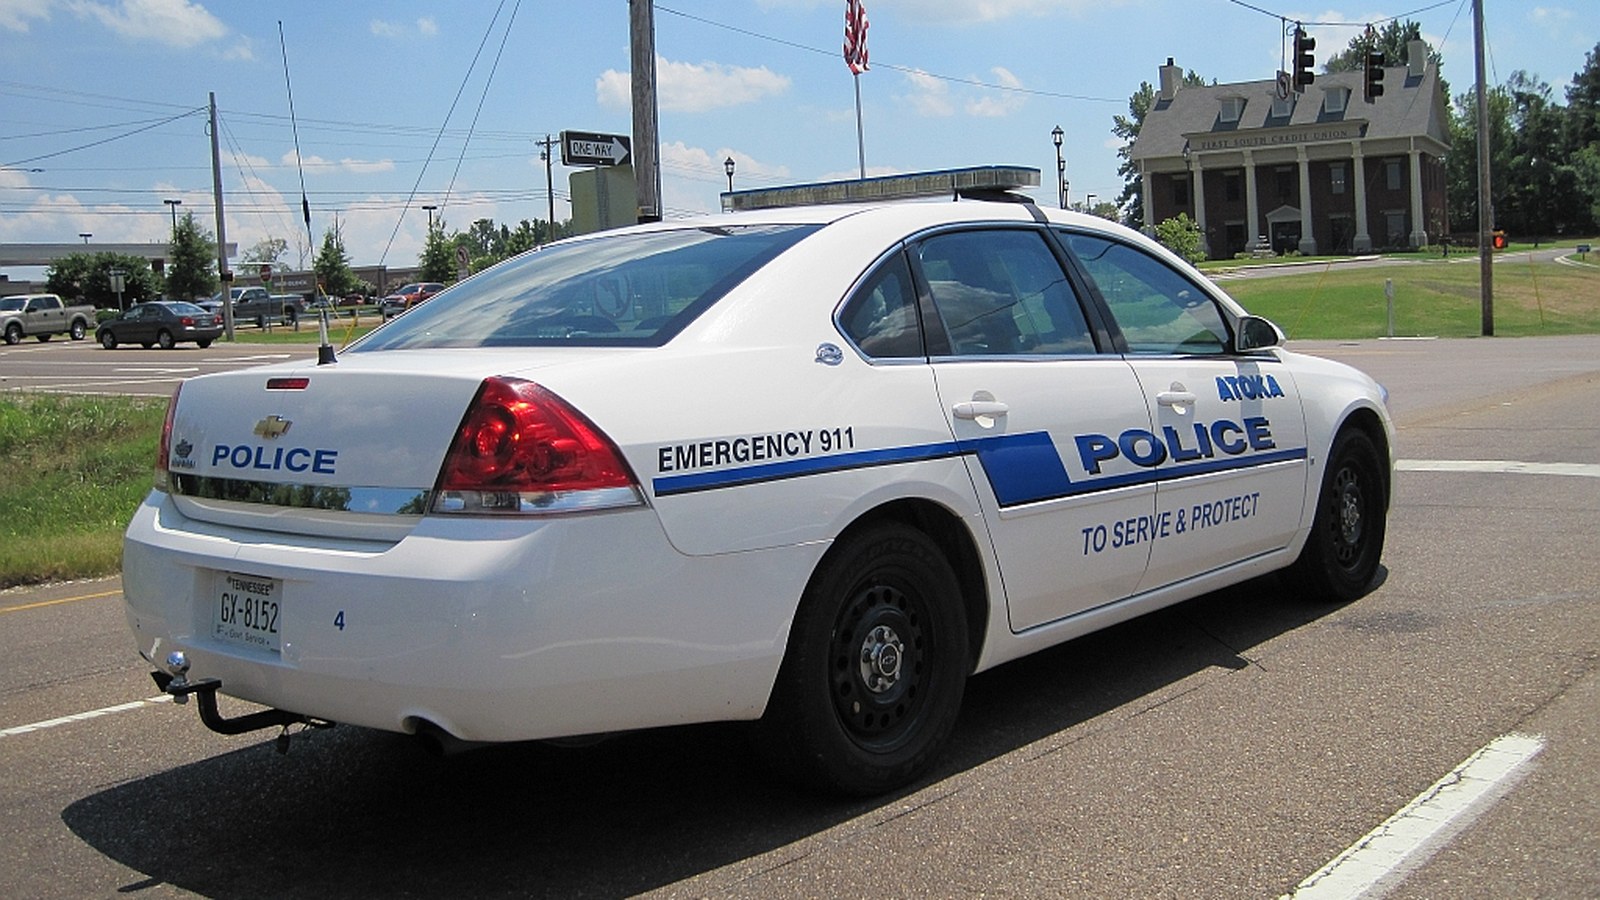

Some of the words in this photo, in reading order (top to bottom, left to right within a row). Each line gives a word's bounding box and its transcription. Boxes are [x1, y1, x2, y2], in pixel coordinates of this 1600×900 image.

[573, 141, 591, 155] ONE
[593, 143, 613, 157] WAY
[1201, 140, 1229, 149] FIRST
[1234, 136, 1267, 147] SOUTH
[1271, 133, 1307, 144] CREDIT
[1313, 130, 1348, 140] UNION
[1215, 375, 1285, 402] ATOKA
[212, 445, 338, 474] POLICE
[658, 430, 813, 472] EMERGENCY
[819, 426, 855, 452] 911
[1074, 416, 1276, 475] POLICE
[1082, 525, 1107, 556] TO
[1112, 512, 1171, 548] SERVE
[1175, 508, 1187, 534] &
[1191, 492, 1260, 531] PROTECT
[232, 578, 270, 596] TENNESSEE
[221, 593, 279, 633] GX-8152
[334, 610, 345, 631] 4
